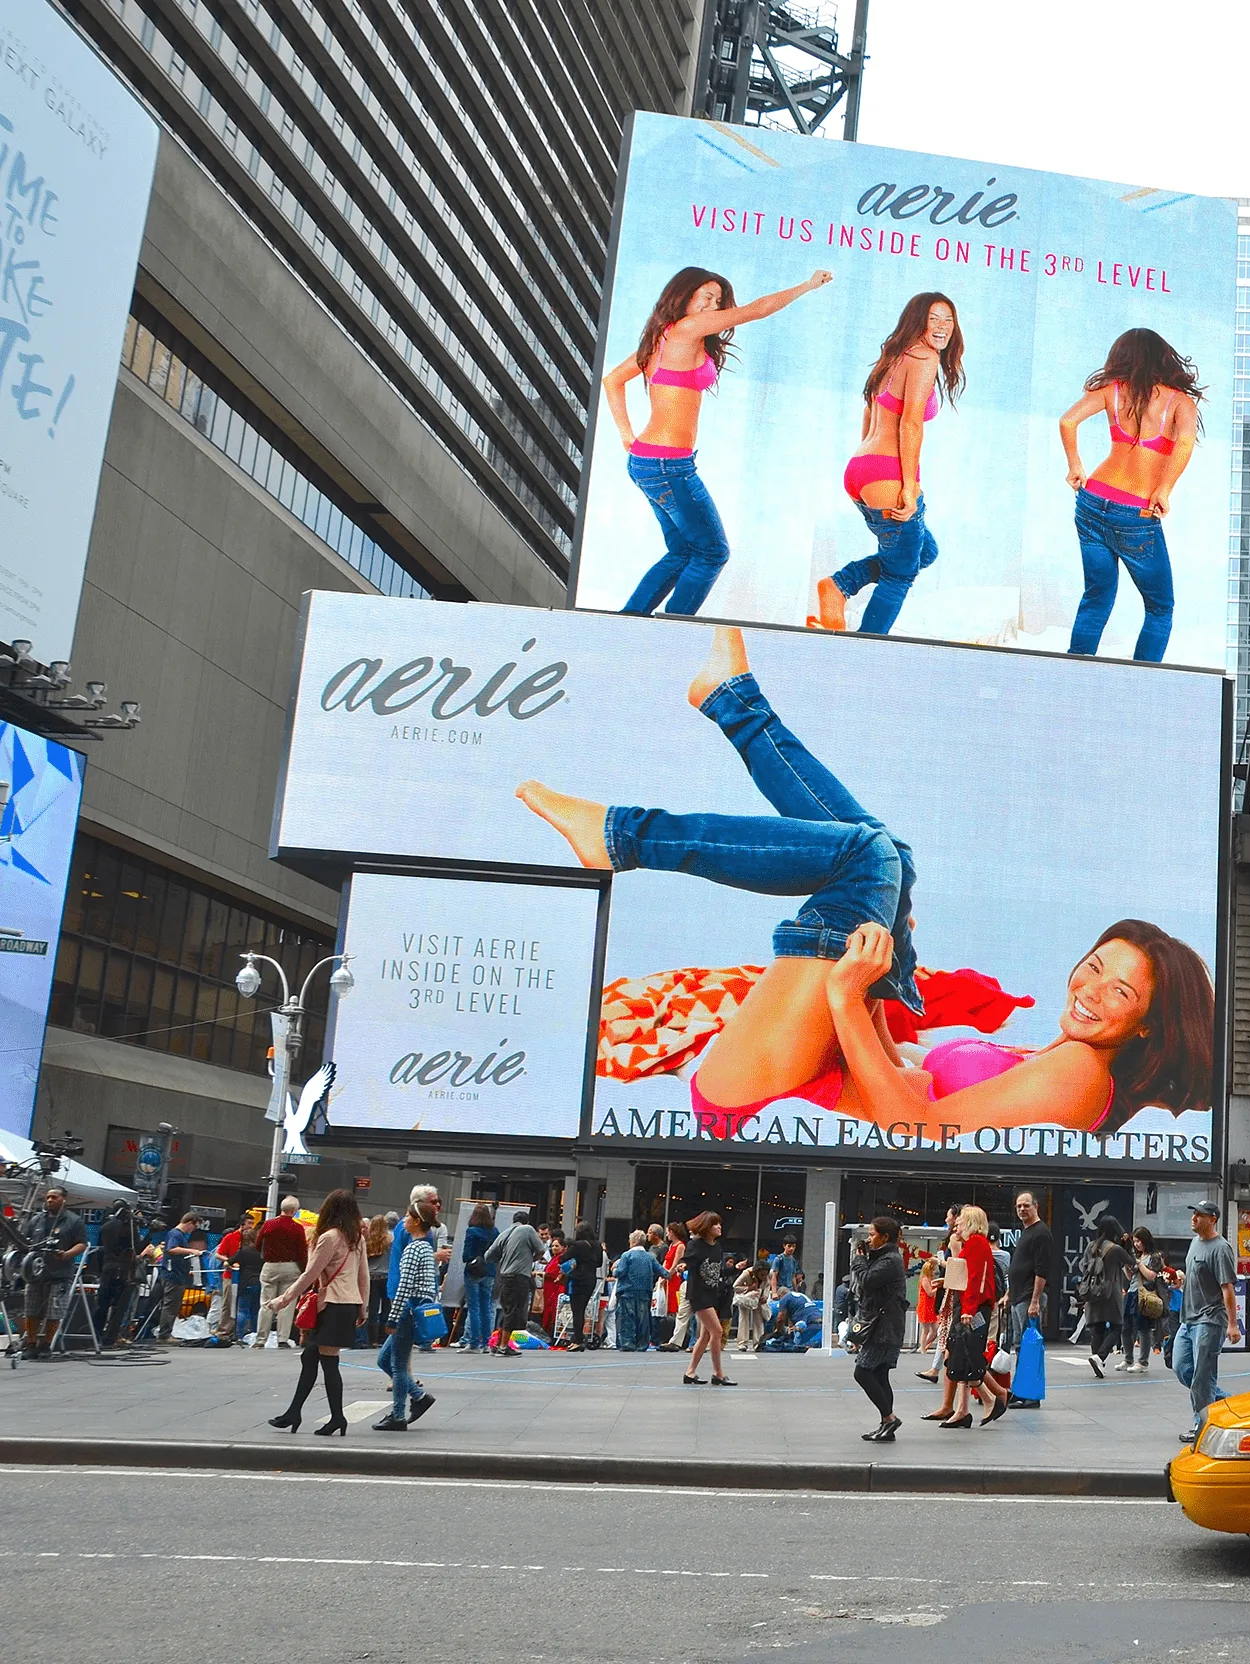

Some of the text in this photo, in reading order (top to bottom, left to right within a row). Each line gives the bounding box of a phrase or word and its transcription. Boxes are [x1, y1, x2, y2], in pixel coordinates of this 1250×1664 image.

[0, 38, 40, 90] EXT
[44, 87, 107, 160] GALAXY
[857, 177, 1019, 228] aerie
[692, 205, 1172, 293] VISIT US INSIDE ON THE 3RD LEVEL
[320, 637, 569, 720] aerie
[391, 725, 483, 746] AERIE.COM
[403, 933, 540, 961] VISIT AERIE
[381, 959, 555, 990] INSIDE ON THE
[408, 988, 522, 1015] 3RD LEVEL
[389, 1038, 526, 1087] aerie
[428, 1090, 480, 1101] AERIE.COM
[597, 1107, 1210, 1162] AMERICAN EAGLE OUTFITTERS
